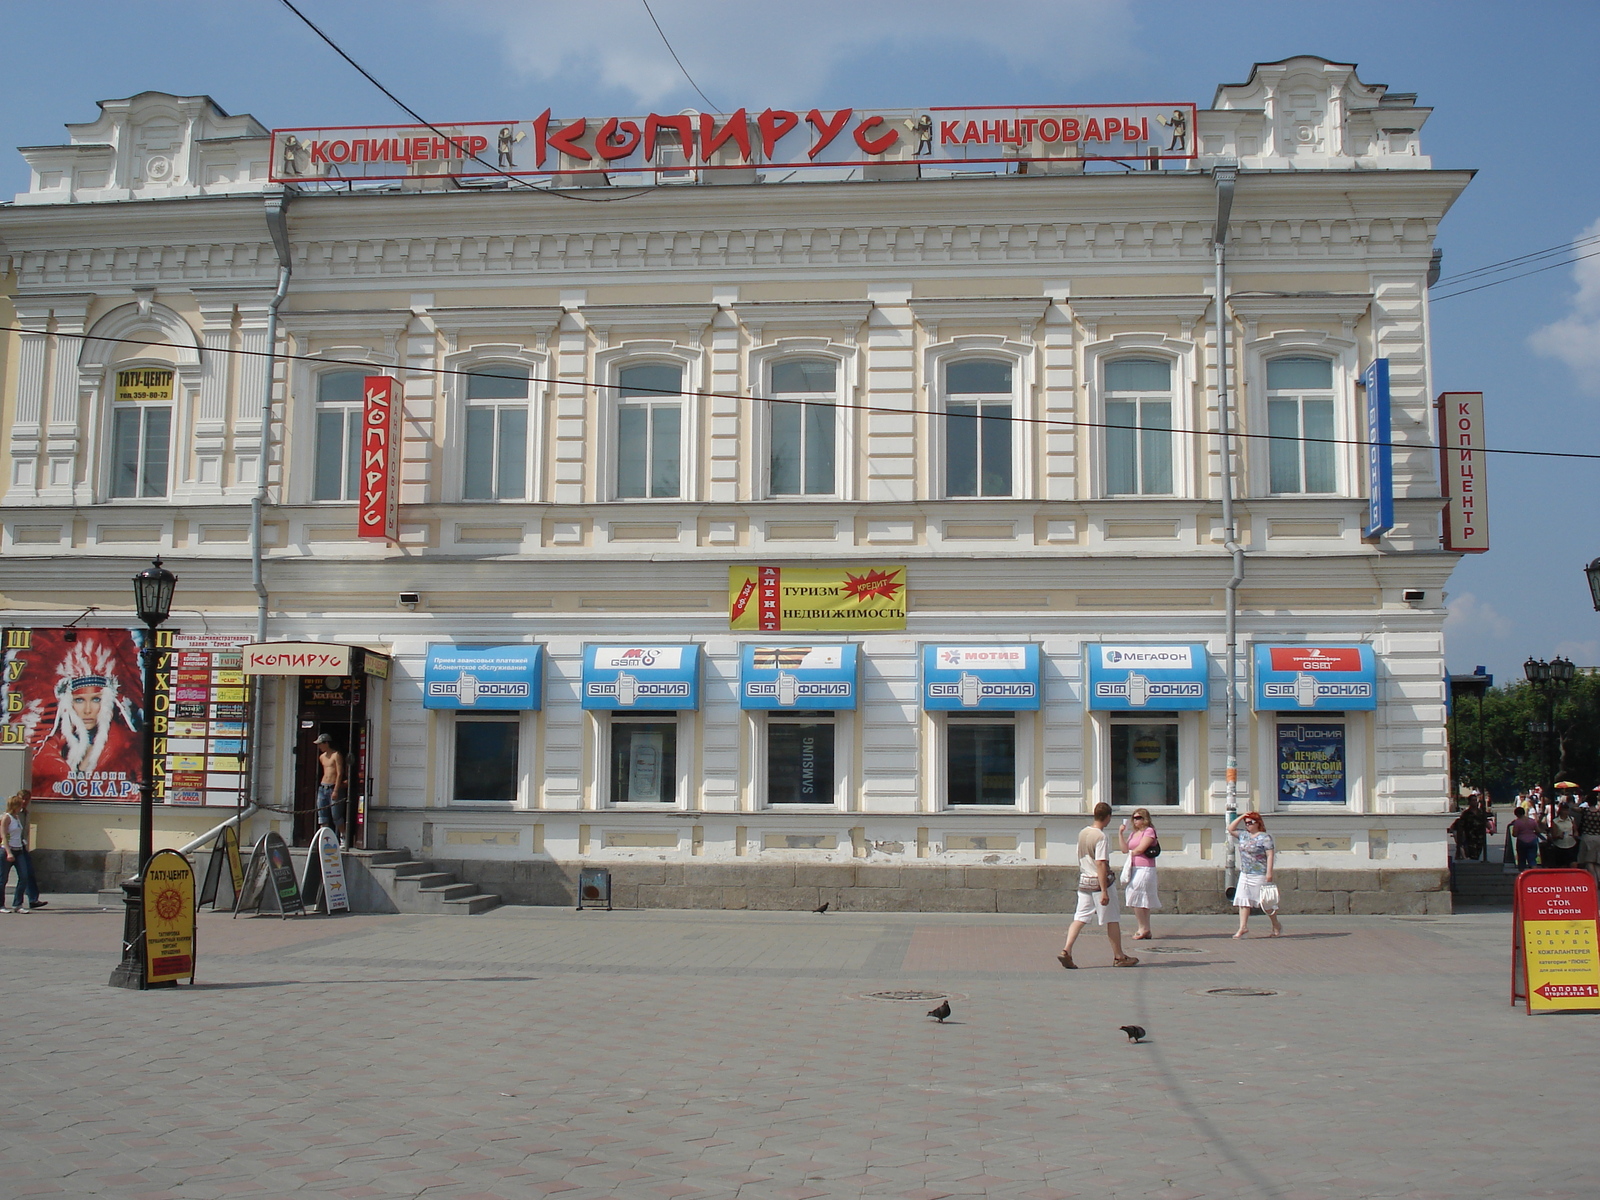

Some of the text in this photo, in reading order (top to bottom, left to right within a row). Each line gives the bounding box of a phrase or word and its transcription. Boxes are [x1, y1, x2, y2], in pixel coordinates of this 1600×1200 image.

[940, 116, 1149, 146] КАНЦТОВАРЫ
[532, 107, 899, 169] КОПИРУС
[310, 135, 488, 165] КОПИЦЕНТР
[119, 371, 173, 389] ТАТУ-ЦЕНТР
[133, 391, 168, 399] 359-80-73
[363, 388, 388, 526] КОПИРУС
[388, 392, 399, 529] КАНЦТОВАРЫ
[1458, 402, 1475, 540] КОПИЦЕНТР
[857, 578, 888, 592] КРЕДИТ
[783, 586, 839, 596] ТУРИЗМ
[763, 568, 776, 629] АЛЕНАТ
[783, 608, 905, 619] НЕДВИЖИМОСТЬ
[250, 653, 341, 668] КОПИРУС
[965, 652, 1019, 660] МОТИВ
[611, 659, 641, 667] GSM
[2, 630, 31, 743] ШУБЫ
[479, 684, 526, 694] ФОНИЯ
[637, 684, 686, 694] ФОНИЯ
[798, 684, 847, 694] ФОНИЯ
[981, 685, 1031, 695] ФОНИЯ
[1149, 685, 1199, 694] ФОНИЯ
[1317, 685, 1368, 695] ФОНИЯ
[152, 631, 173, 798] ПУХОВИКИ
[1294, 751, 1327, 761] ПЕЧАТЬ
[802, 737, 814, 794] SAMSUNG
[1281, 760, 1342, 771] ФОТОГРАФИЙ
[68, 771, 126, 780] МАГАЗИН
[150, 869, 189, 881] ТАТУ-ЦЕНТР
